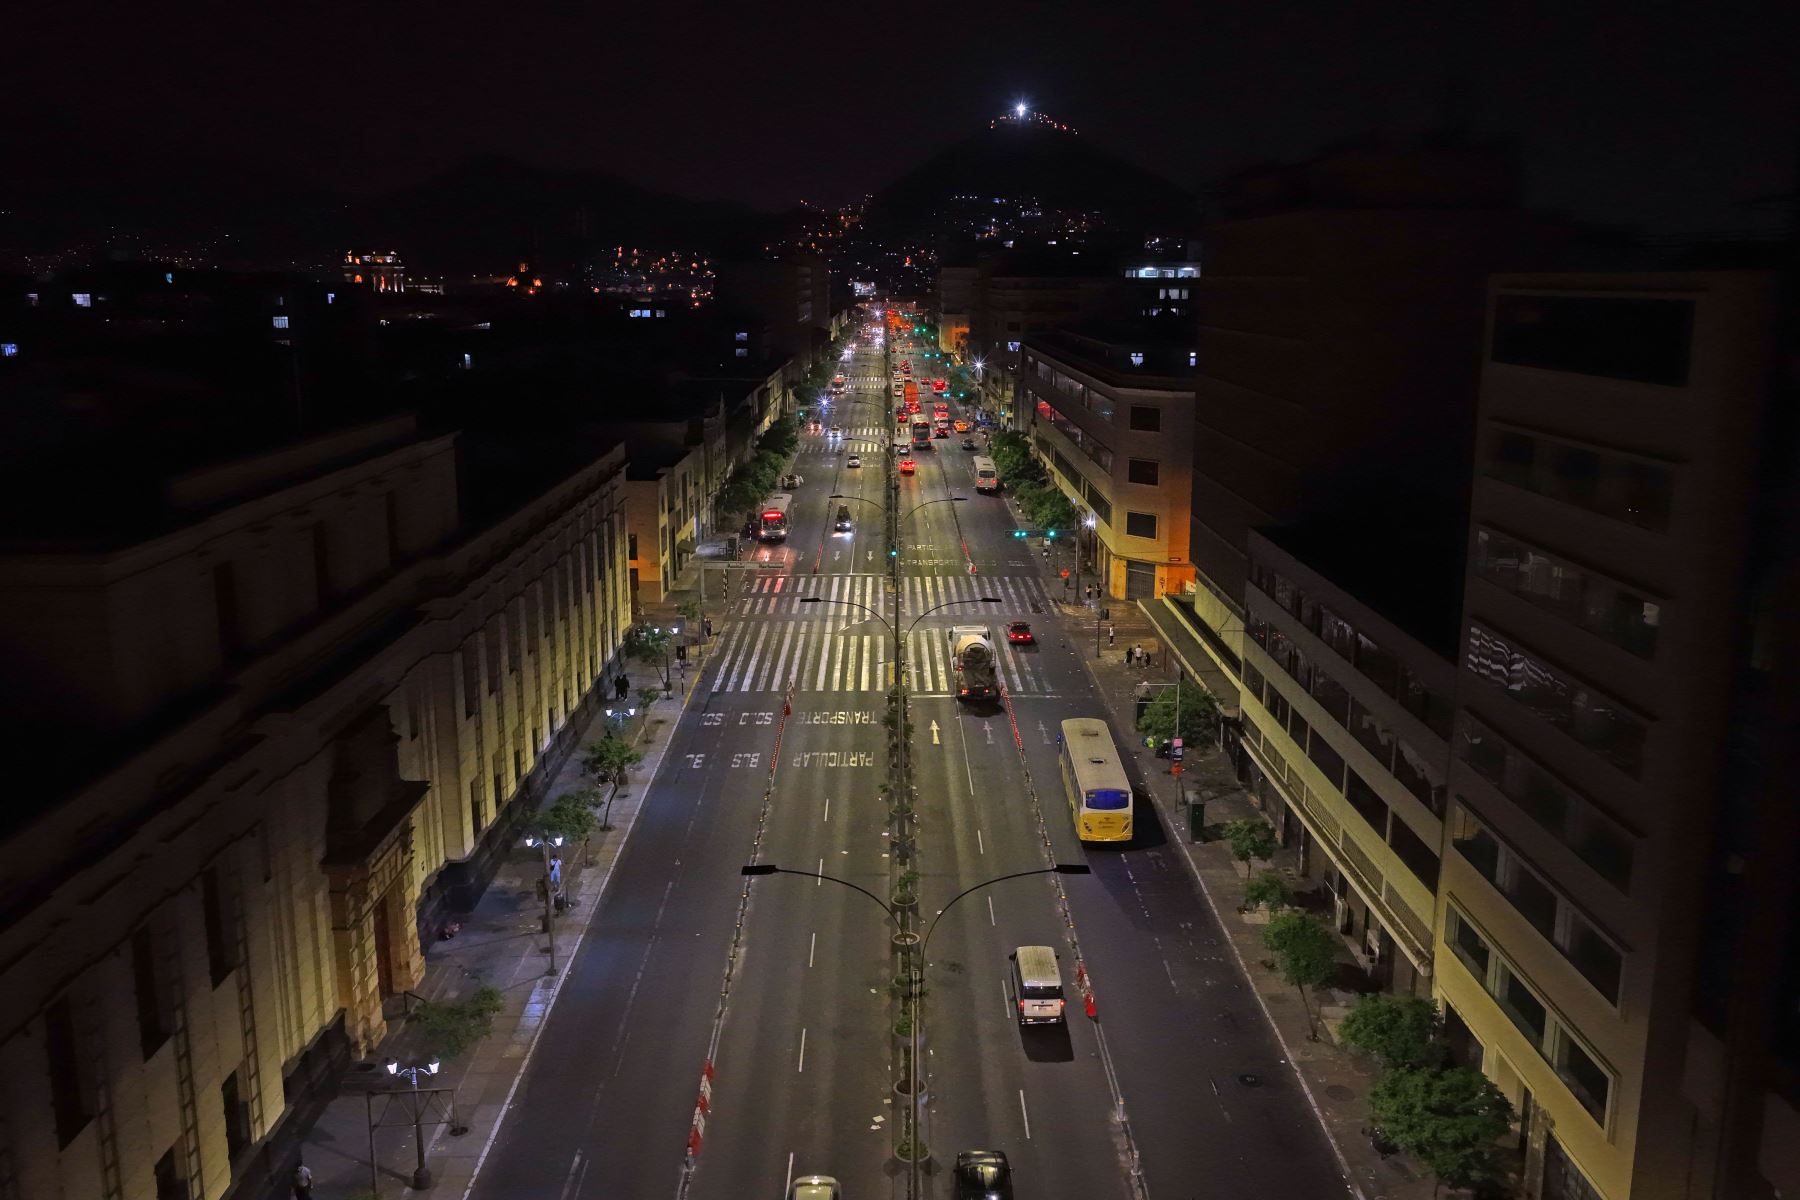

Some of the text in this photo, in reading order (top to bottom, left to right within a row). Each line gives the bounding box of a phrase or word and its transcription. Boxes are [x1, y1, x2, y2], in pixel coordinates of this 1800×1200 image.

[739, 711, 774, 726] SOO
[796, 711, 878, 725] TRANSPORTE
[792, 751, 874, 768] PARTICULAR
